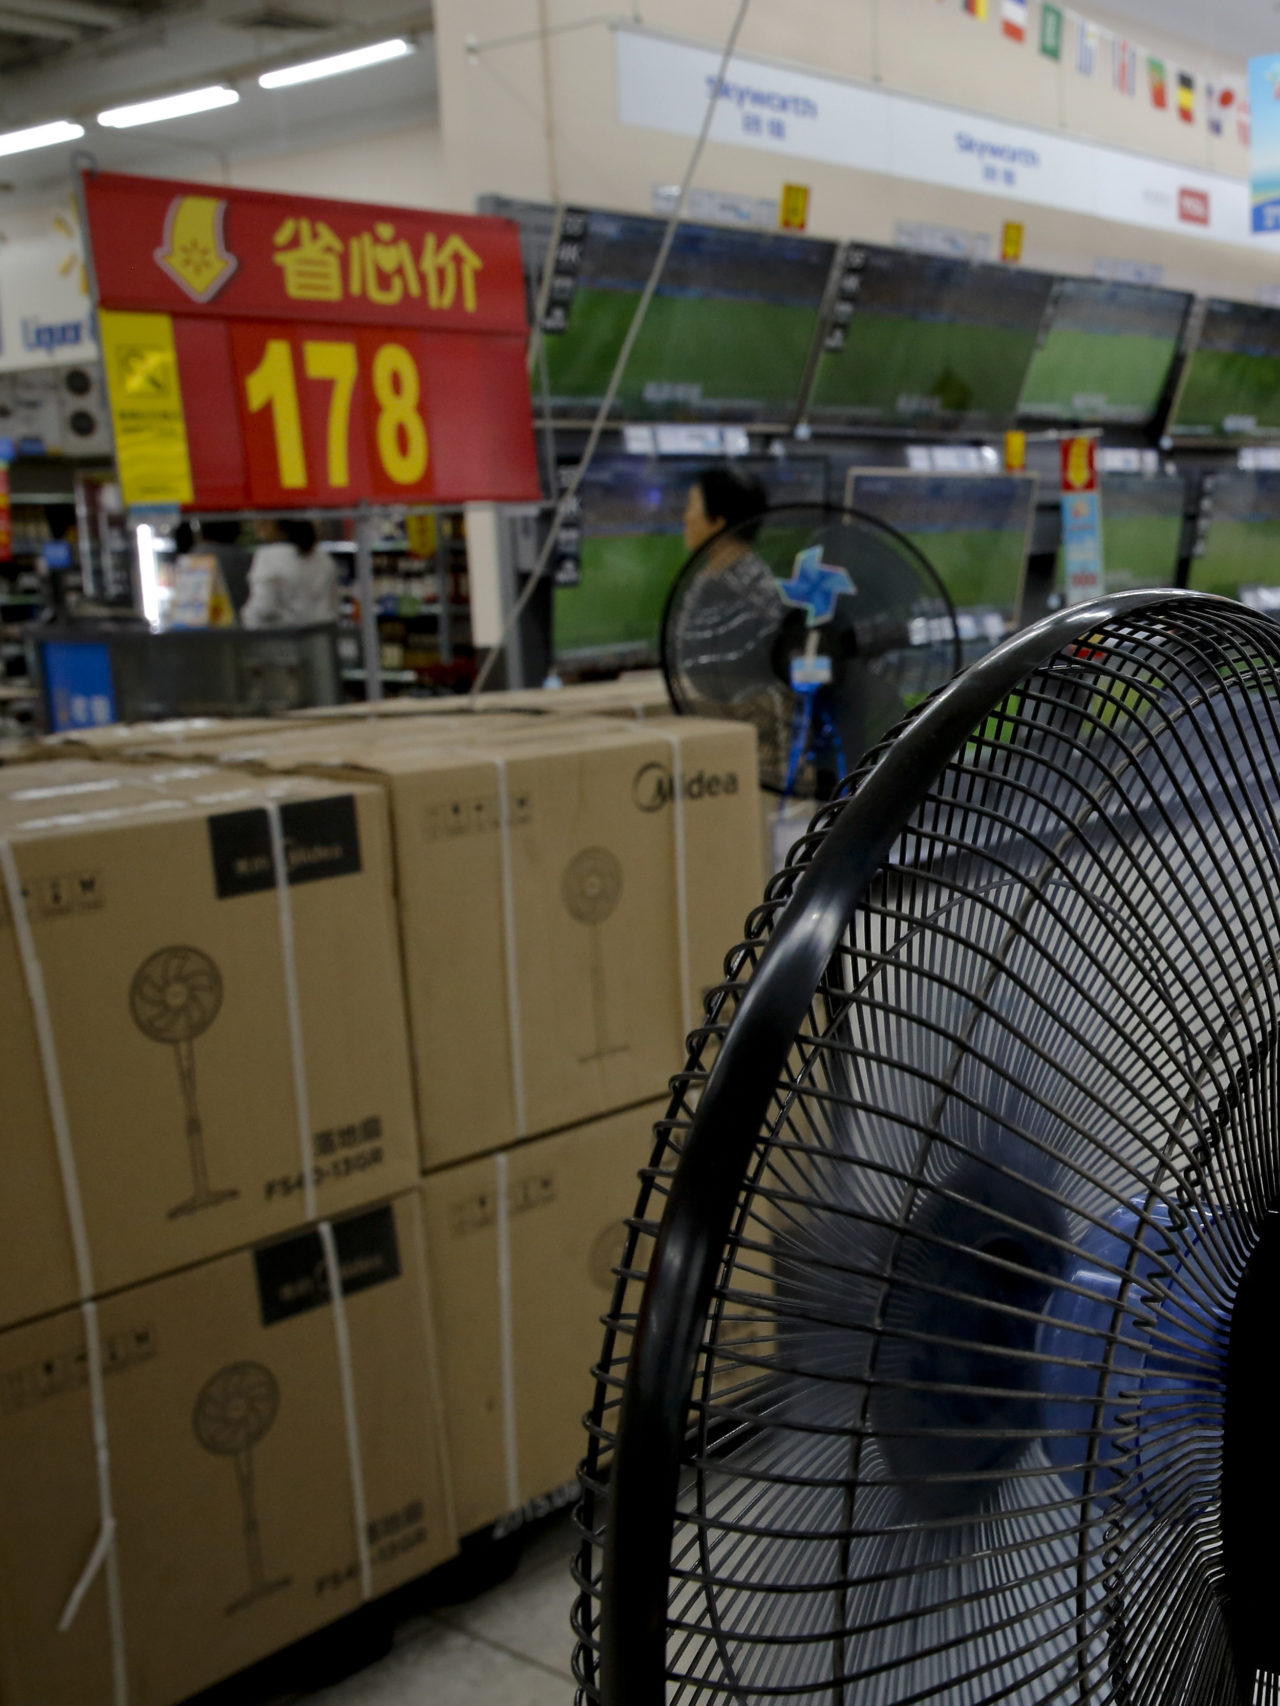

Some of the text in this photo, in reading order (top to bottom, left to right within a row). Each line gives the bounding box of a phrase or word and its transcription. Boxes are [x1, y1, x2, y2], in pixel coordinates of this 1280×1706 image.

[273, 217, 482, 312] 省心价
[245, 339, 428, 489] 178
[631, 761, 739, 814] Mdea
